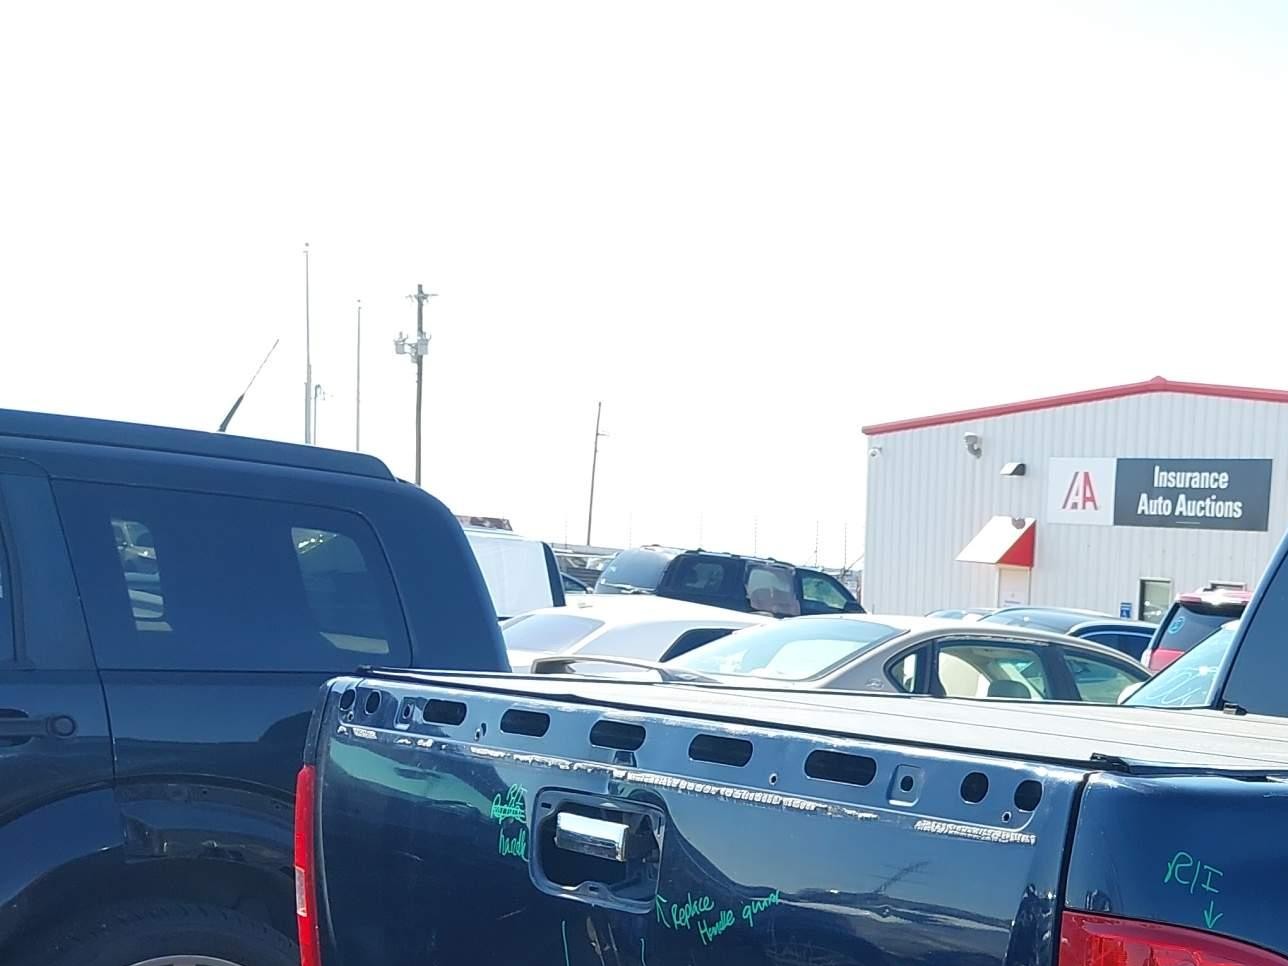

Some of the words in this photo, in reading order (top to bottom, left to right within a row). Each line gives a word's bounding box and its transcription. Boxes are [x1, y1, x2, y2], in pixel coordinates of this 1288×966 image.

[1154, 465, 1229, 489] Insurance
[1137, 493, 1171, 516] Auto
[1174, 494, 1243, 521] Auctions
[671, 892, 714, 930] Replace
